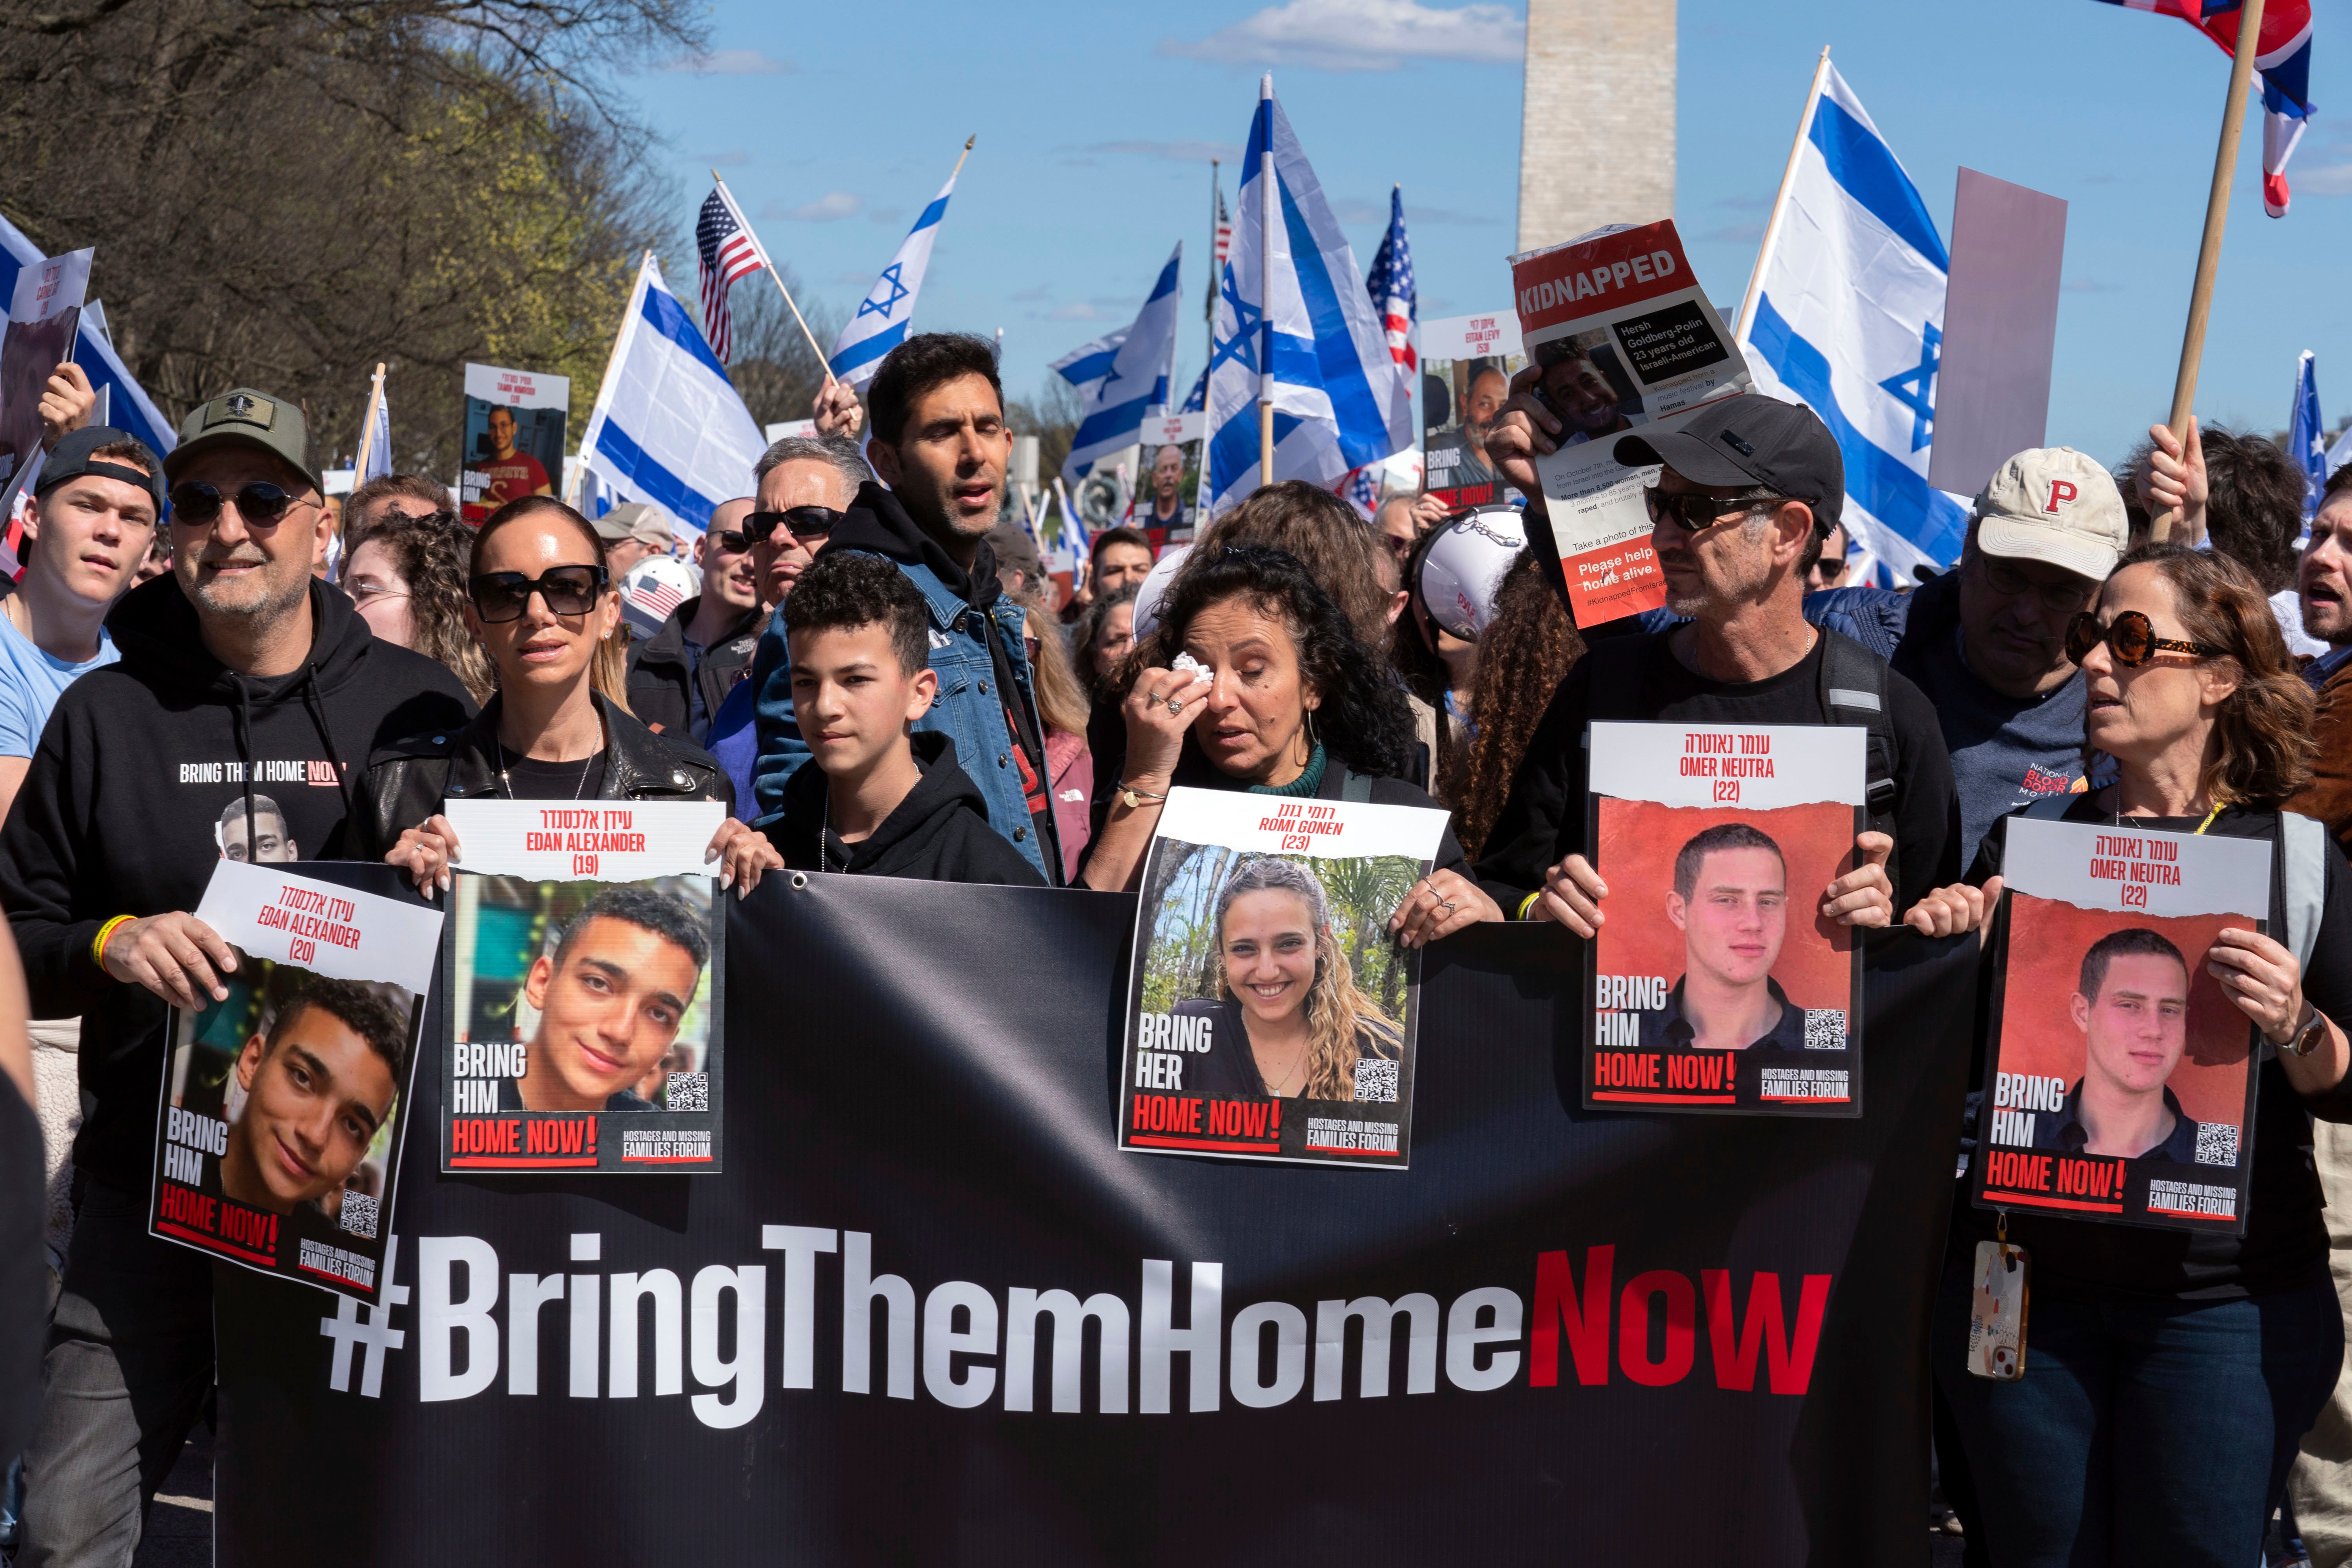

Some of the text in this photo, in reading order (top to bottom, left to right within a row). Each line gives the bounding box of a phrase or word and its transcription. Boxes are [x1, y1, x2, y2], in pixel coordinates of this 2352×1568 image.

[1520, 250, 1675, 317] KIDNAPPED
[1466, 329, 1500, 343] EITAN LEVY
[1621, 321, 1651, 336] Hersh
[1628, 319, 1703, 348] Goldberg-Polin
[1477, 342, 1490, 355] (53)
[1633, 334, 1695, 361] 23 years old
[1639, 341, 1716, 371] Israeli-American
[1653, 376, 1692, 392] Kidnapped
[1692, 371, 1709, 381] from
[1657, 391, 1678, 402] music
[1680, 381, 1704, 395] festival
[1660, 400, 1686, 412] Hamas
[1427, 448, 1460, 469] BRING
[1566, 466, 1592, 477] October
[1593, 463, 1605, 471] 7th,
[464, 470, 490, 489] BRING
[1428, 469, 1449, 489] HIM
[1561, 492, 1579, 501] More
[1579, 487, 1595, 495] than
[1596, 481, 1614, 491] 8,500
[1615, 474, 1641, 485] women,
[1641, 468, 1657, 477] men,
[1573, 475, 1590, 485] Israel
[463, 486, 481, 503] HIM
[1461, 482, 1493, 506] NOW!
[1577, 495, 1600, 506] months
[1618, 484, 1635, 494] years
[1578, 504, 1599, 514] raped,
[1601, 499, 1613, 508] and
[1614, 492, 1637, 504] brutally
[2044, 479, 2078, 514] P
[1572, 541, 1593, 551] Take
[1603, 532, 1627, 545] photo
[1629, 526, 1637, 535] of
[1639, 523, 1654, 533] this
[1578, 547, 1653, 576] Please help
[1622, 565, 1656, 581] alive.
[1588, 580, 1667, 606] #KidnappedFromIsrae
[1685, 733, 1770, 754] עומר נאוטרה
[180, 762, 222, 783] BRING
[225, 761, 263, 782] THEM
[266, 761, 306, 781] HOME
[1680, 757, 1775, 778] OMER NEUTRA
[2027, 769, 2069, 785] BLOOD
[2030, 763, 2070, 777] NATIONAL
[1713, 779, 1740, 803] (22)
[2023, 778, 2065, 794] DONOR
[540, 809, 632, 831] עידן אלכסנדר
[1278, 804, 1336, 820] רומי גונן
[1259, 817, 1344, 835] ROMI GONEN
[527, 832, 645, 852] EDAN ALEXANDER
[1281, 834, 1310, 851] (23)
[2096, 835, 2178, 862] עומר נאוטרה
[573, 854, 599, 876] (19)
[2090, 858, 2181, 886] OMER NEUTRA
[279, 886, 355, 922] עידן אלכסנדר
[2121, 883, 2147, 908] (22)
[257, 905, 361, 950] EDAN ALEXANDER
[289, 937, 315, 965] (20)
[1596, 975, 1666, 1011] BRING
[1138, 1012, 1212, 1053] BRING
[1595, 1012, 1639, 1047] HIM
[454, 1044, 526, 1078] BRING
[1135, 1051, 1183, 1090] HER
[1595, 1052, 1736, 1091] HOME NOW!
[1761, 1068, 1849, 1082] HOSTAGES AND MISSING
[453, 1080, 498, 1113] HIM
[1761, 1080, 1848, 1098] FAMILIES FORUM
[1994, 1071, 2065, 1112] BRING
[1133, 1094, 1282, 1139] HOME NOW!
[1308, 1118, 1398, 1135] HOSTAGES AND MISSING
[1990, 1109, 2036, 1148] HIM
[167, 1106, 228, 1156] BRING
[453, 1116, 598, 1154] HOME NOW!
[623, 1131, 711, 1142] HOSTAGES AND MISSING
[1307, 1130, 1398, 1152] FAMILIES FORUM
[624, 1142, 710, 1158] FAMILIES FORUM
[164, 1143, 203, 1186] HIM
[1987, 1150, 2127, 1200] HOME NOW!
[2150, 1179, 2236, 1200] HOSTAGES AND MISSING
[2149, 1191, 2235, 1217] FAMILIES FORUM
[161, 1183, 279, 1253] HOME NOW!
[301, 1238, 376, 1271] HOSTAGES AND MISSING
[299, 1249, 374, 1288] FAMILIES FORUM
